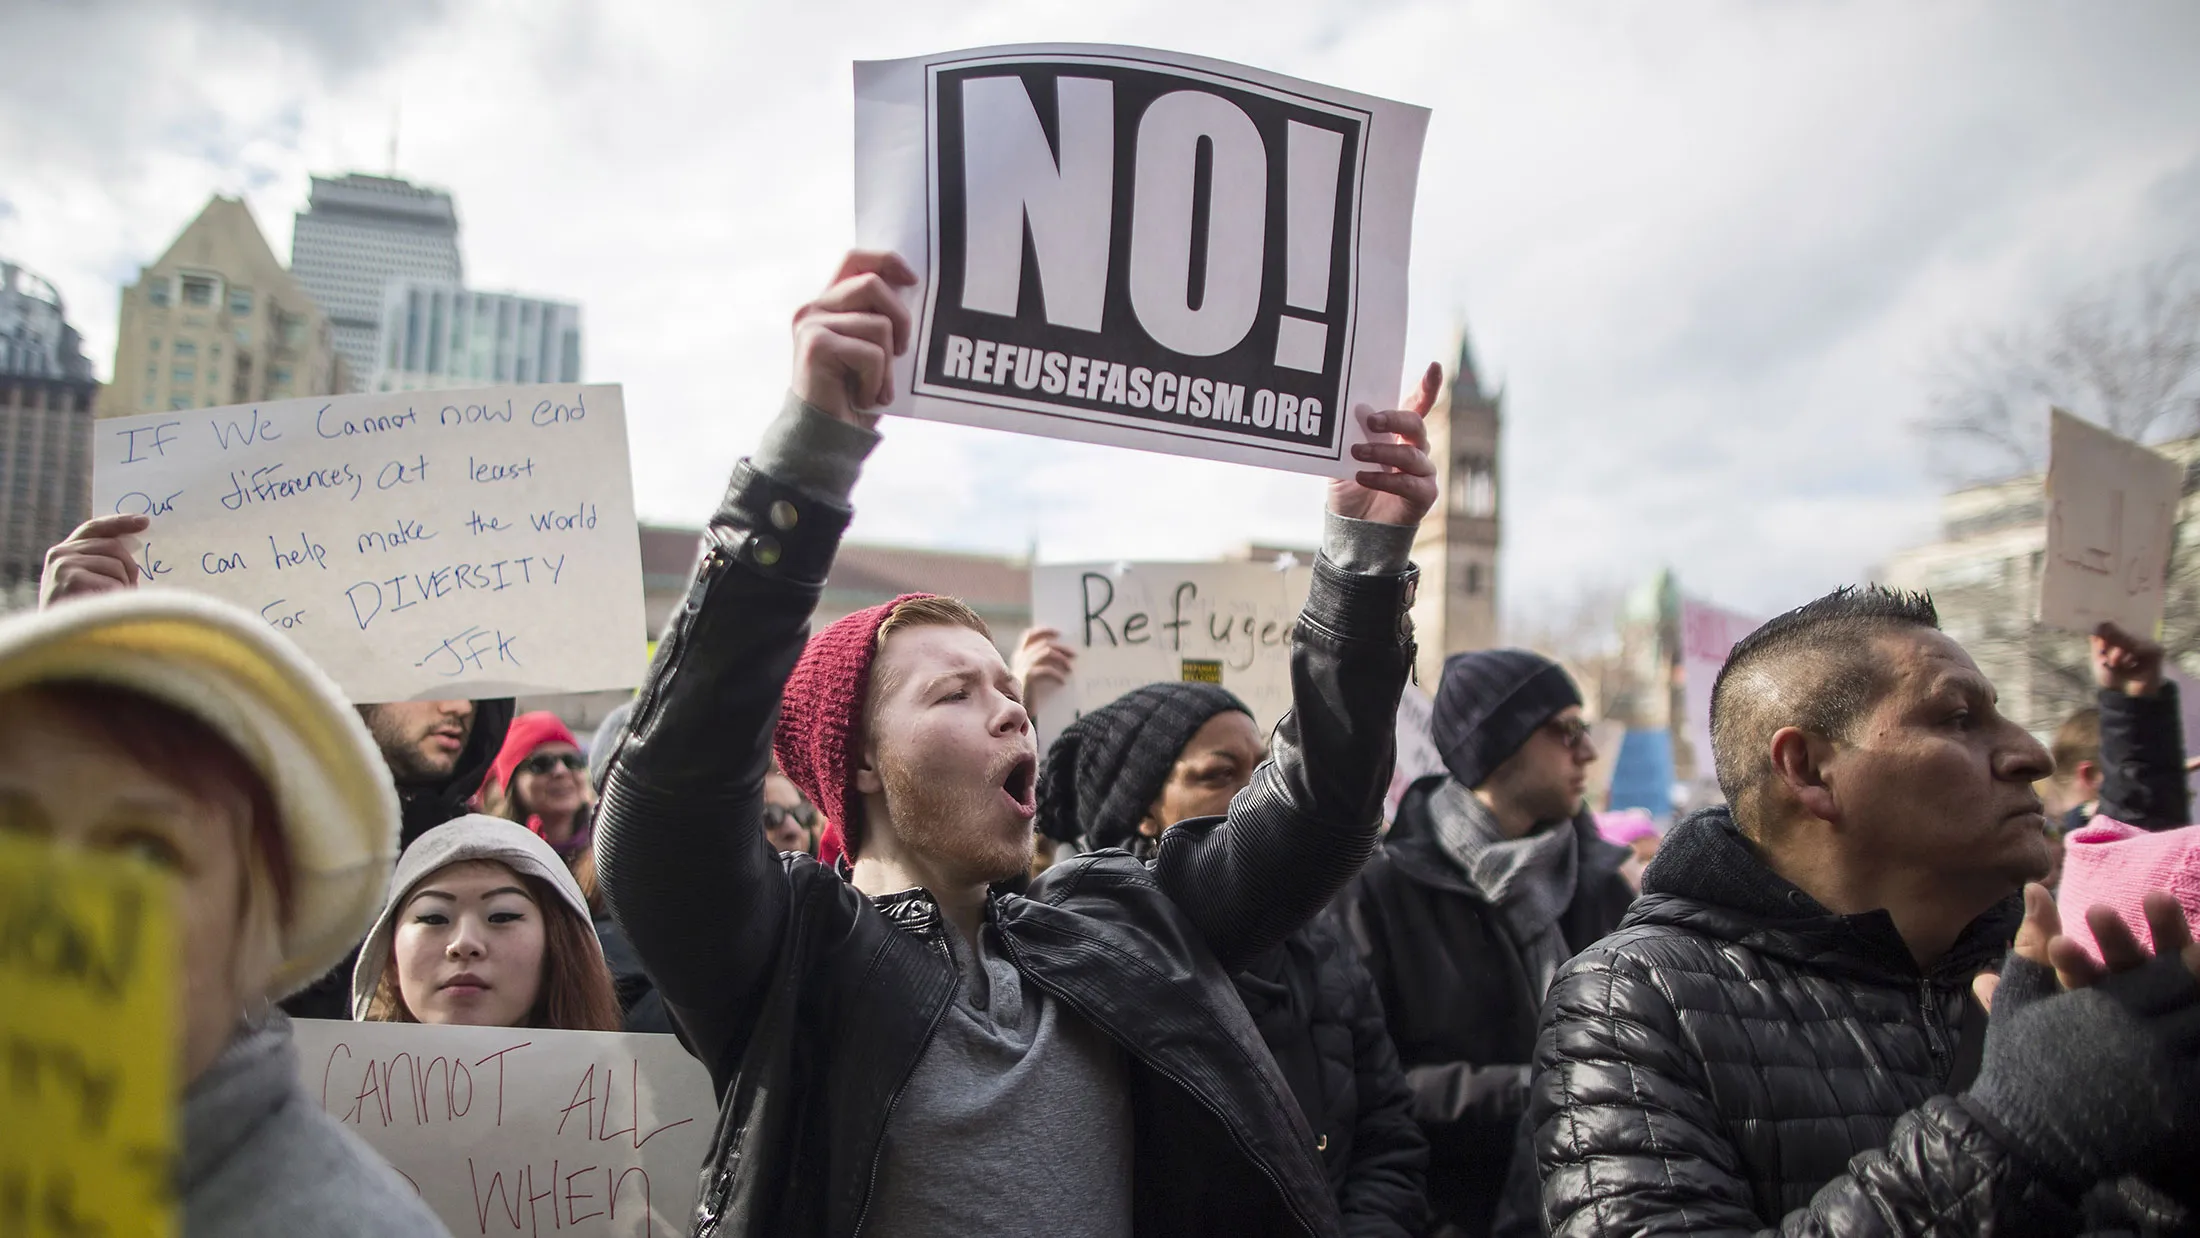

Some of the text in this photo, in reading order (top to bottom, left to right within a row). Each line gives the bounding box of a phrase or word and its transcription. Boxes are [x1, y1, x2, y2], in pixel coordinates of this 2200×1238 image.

[961, 74, 1345, 374] NO!
[211, 409, 282, 451] We
[440, 399, 512, 426] now
[531, 393, 586, 427] end
[942, 334, 1323, 437] REFUSEFASCISM.ORG
[469, 456, 535, 483] least
[269, 532, 328, 570] help
[357, 519, 439, 553] make
[465, 510, 514, 536] the
[345, 554, 565, 630] DIVERSITY
[558, 1058, 693, 1149] ALL
